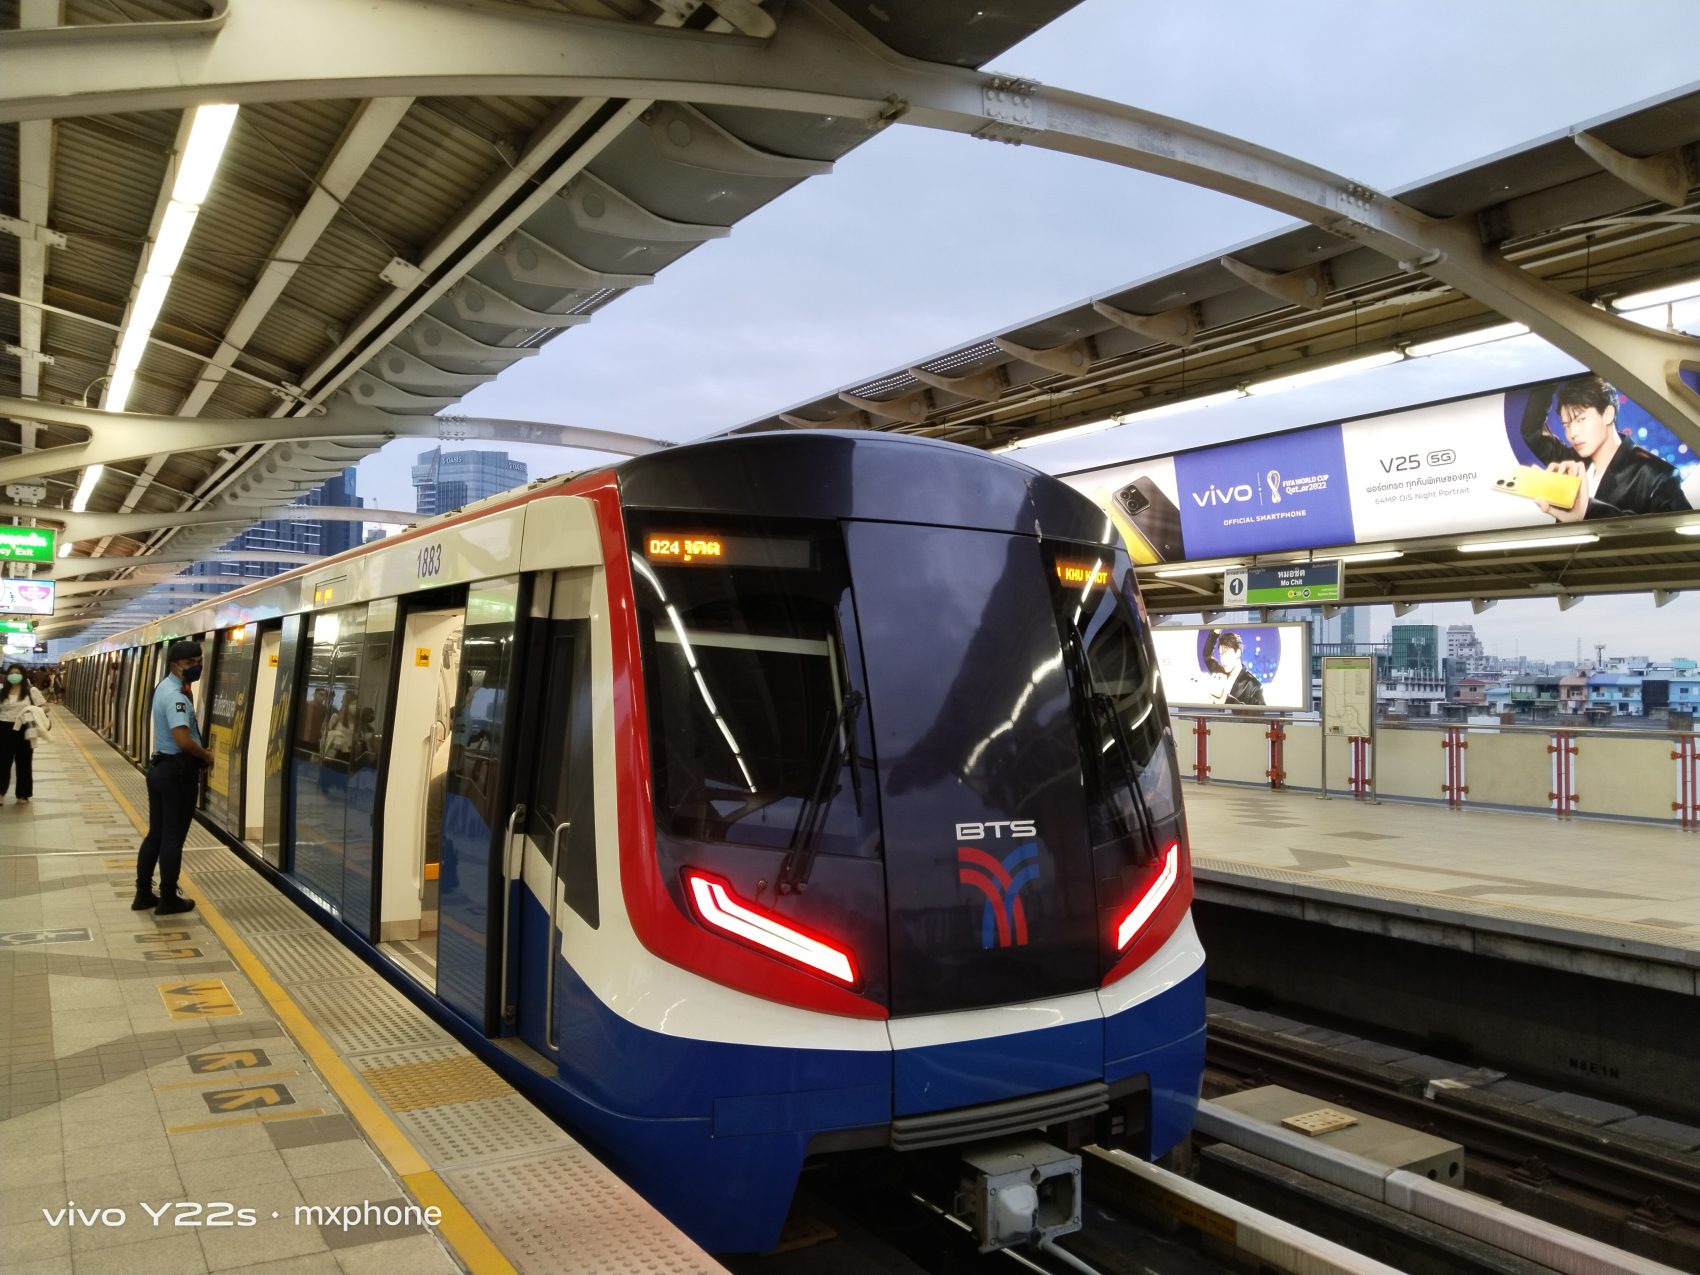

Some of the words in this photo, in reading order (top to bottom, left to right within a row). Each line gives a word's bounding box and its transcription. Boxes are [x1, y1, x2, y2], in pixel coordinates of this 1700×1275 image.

[1379, 454, 1421, 473] V25
[1430, 452, 1452, 464] 5G
[1295, 476, 1316, 485] WORLD
[1317, 474, 1329, 482] CUP
[1192, 484, 1253, 507] vivo
[1374, 495, 1397, 505] 64MP
[1399, 493, 1413, 502] OIS
[1415, 491, 1437, 501] Night
[1438, 487, 1470, 497] Portrait
[1223, 515, 1255, 526] OFFICIAL
[1256, 509, 1307, 522] SMARTPHONE
[15, 547, 34, 556] Exit
[650, 540, 680, 555] 024
[416, 543, 442, 579] 1883
[1065, 567, 1084, 582] KHU
[955, 820, 1037, 841] BTS
